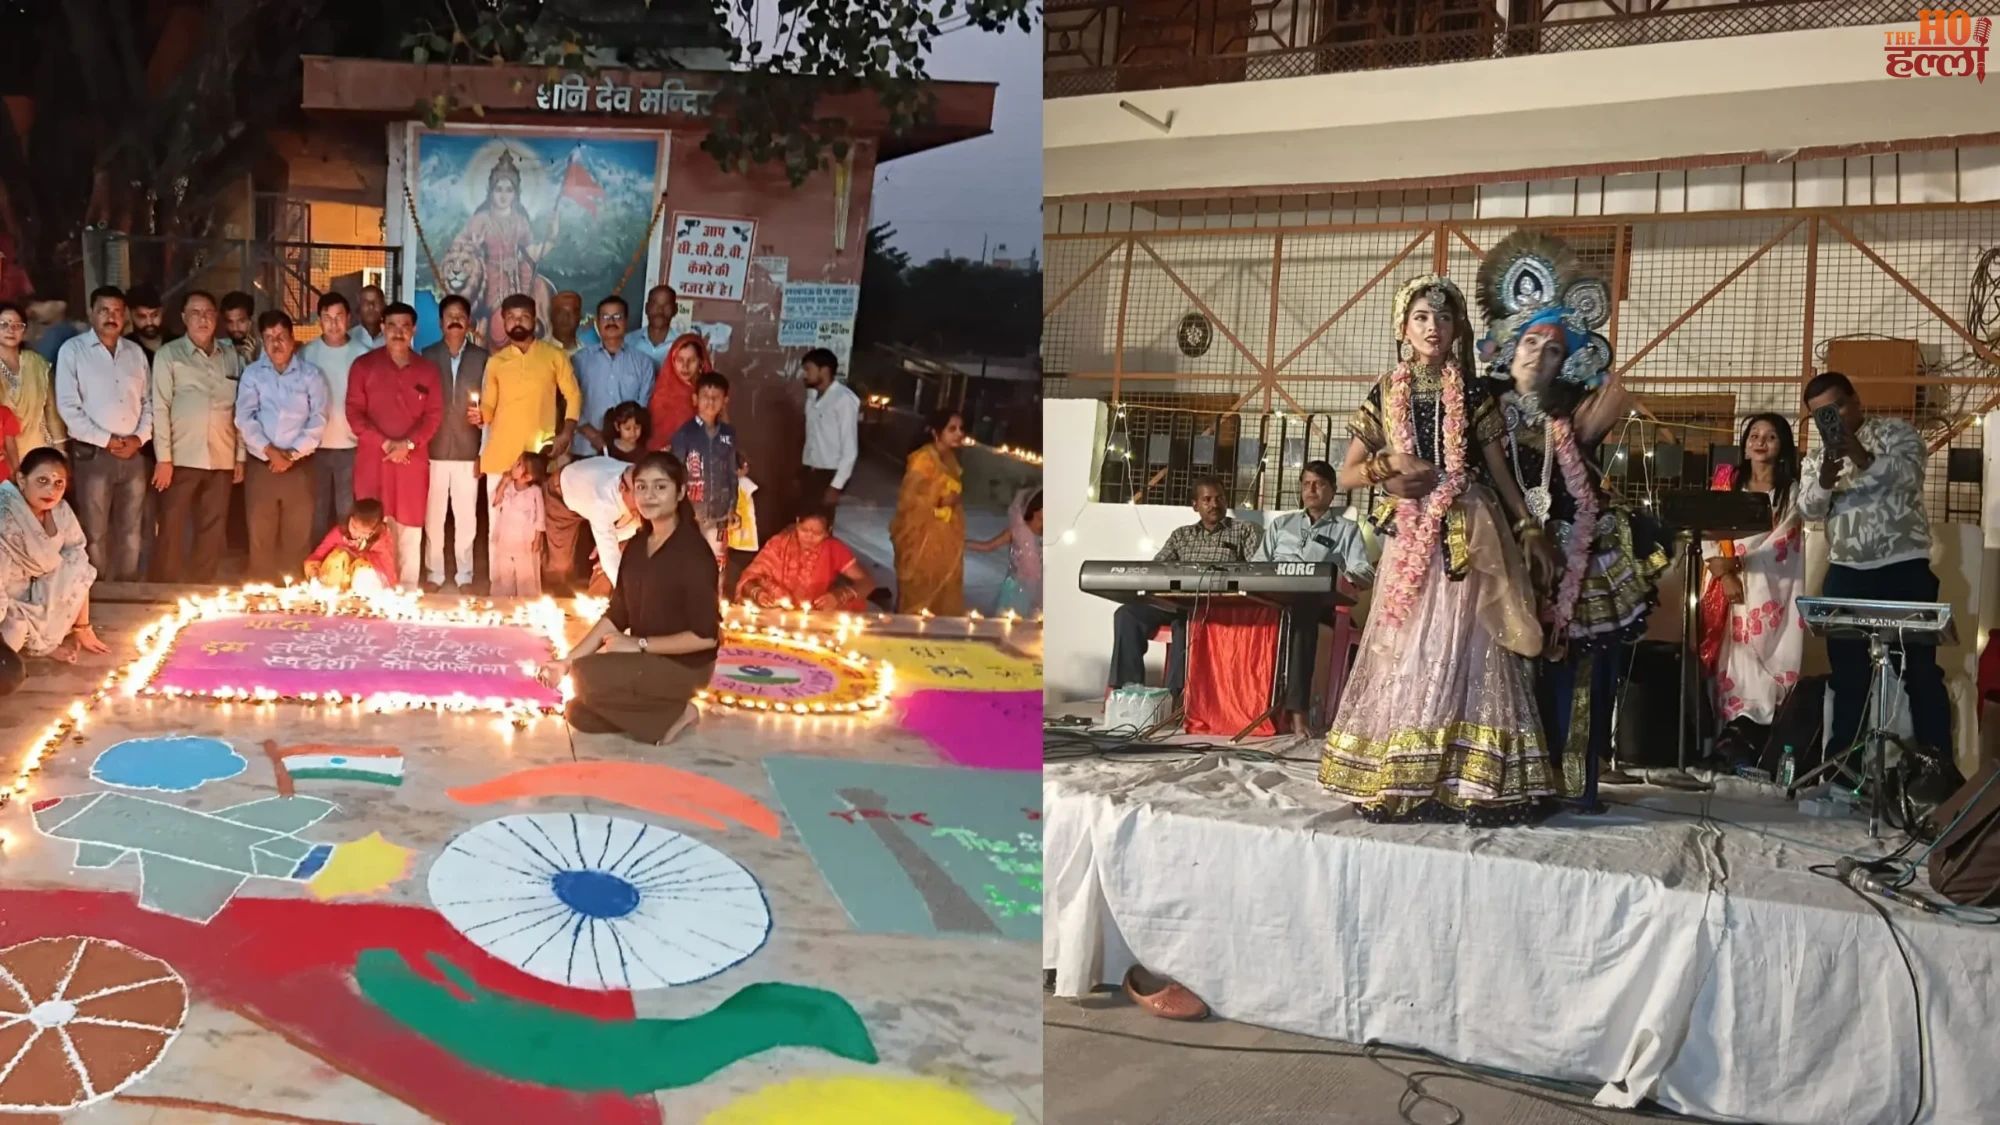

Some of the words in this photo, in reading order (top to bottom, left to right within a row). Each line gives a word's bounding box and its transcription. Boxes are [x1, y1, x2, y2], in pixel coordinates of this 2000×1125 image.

[536, 73, 590, 111] शनि
[595, 77, 633, 112] देव
[703, 225, 727, 238] आप
[715, 262, 730, 277] की
[1275, 562, 1316, 576] KORG
[1852, 618, 1898, 627] ROLAND
